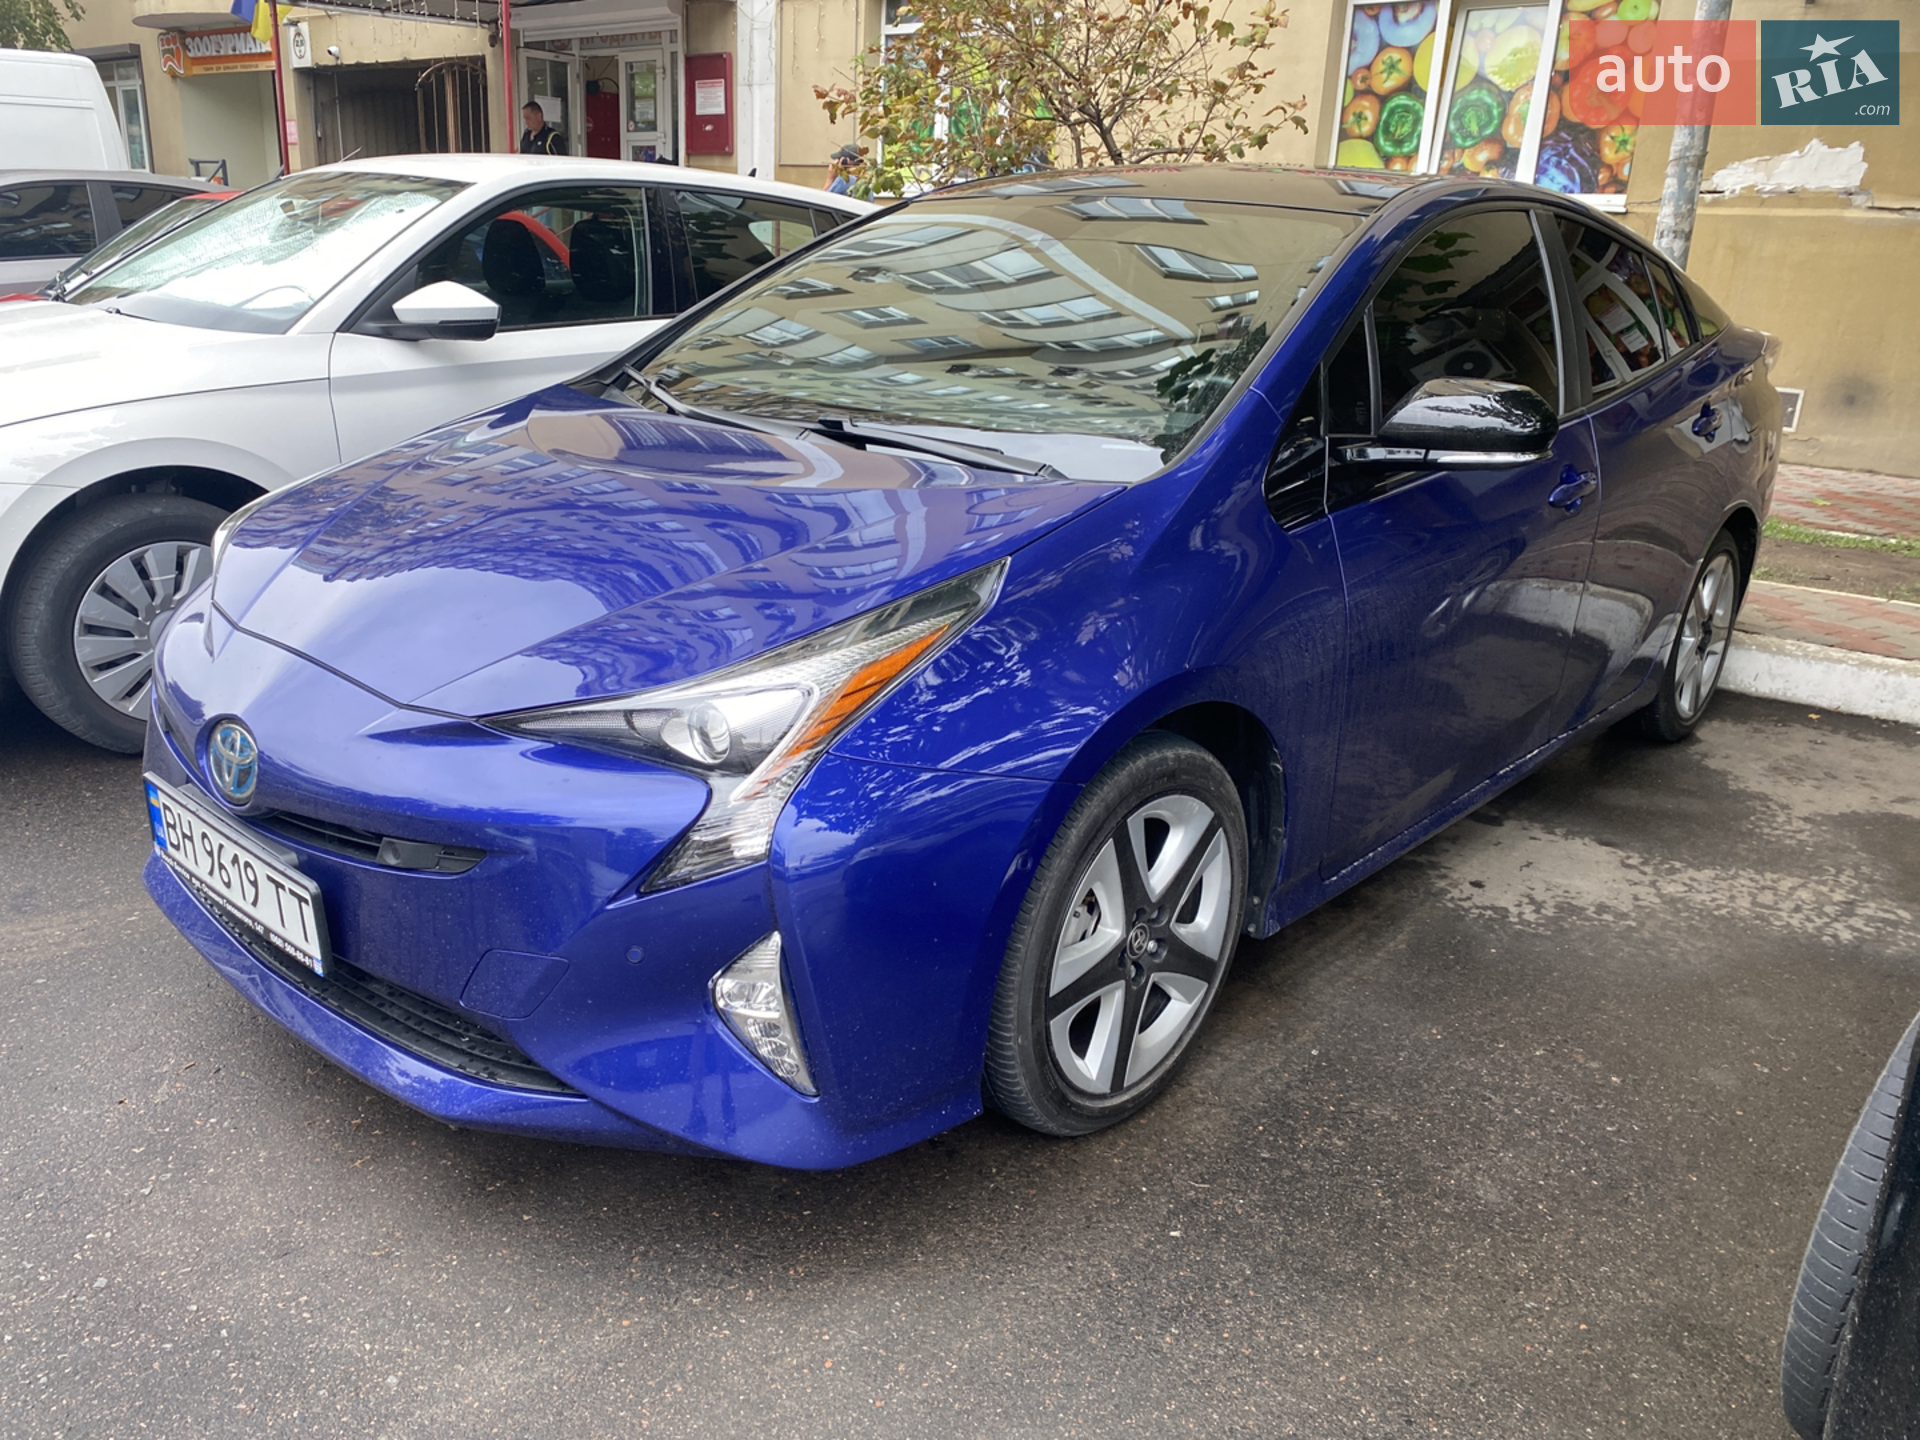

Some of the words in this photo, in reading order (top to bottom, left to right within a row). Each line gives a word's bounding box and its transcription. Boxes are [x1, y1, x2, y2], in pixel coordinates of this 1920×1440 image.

[161, 802, 199, 867] BH
[201, 830, 259, 907] 9619
[266, 872, 310, 944] TT
